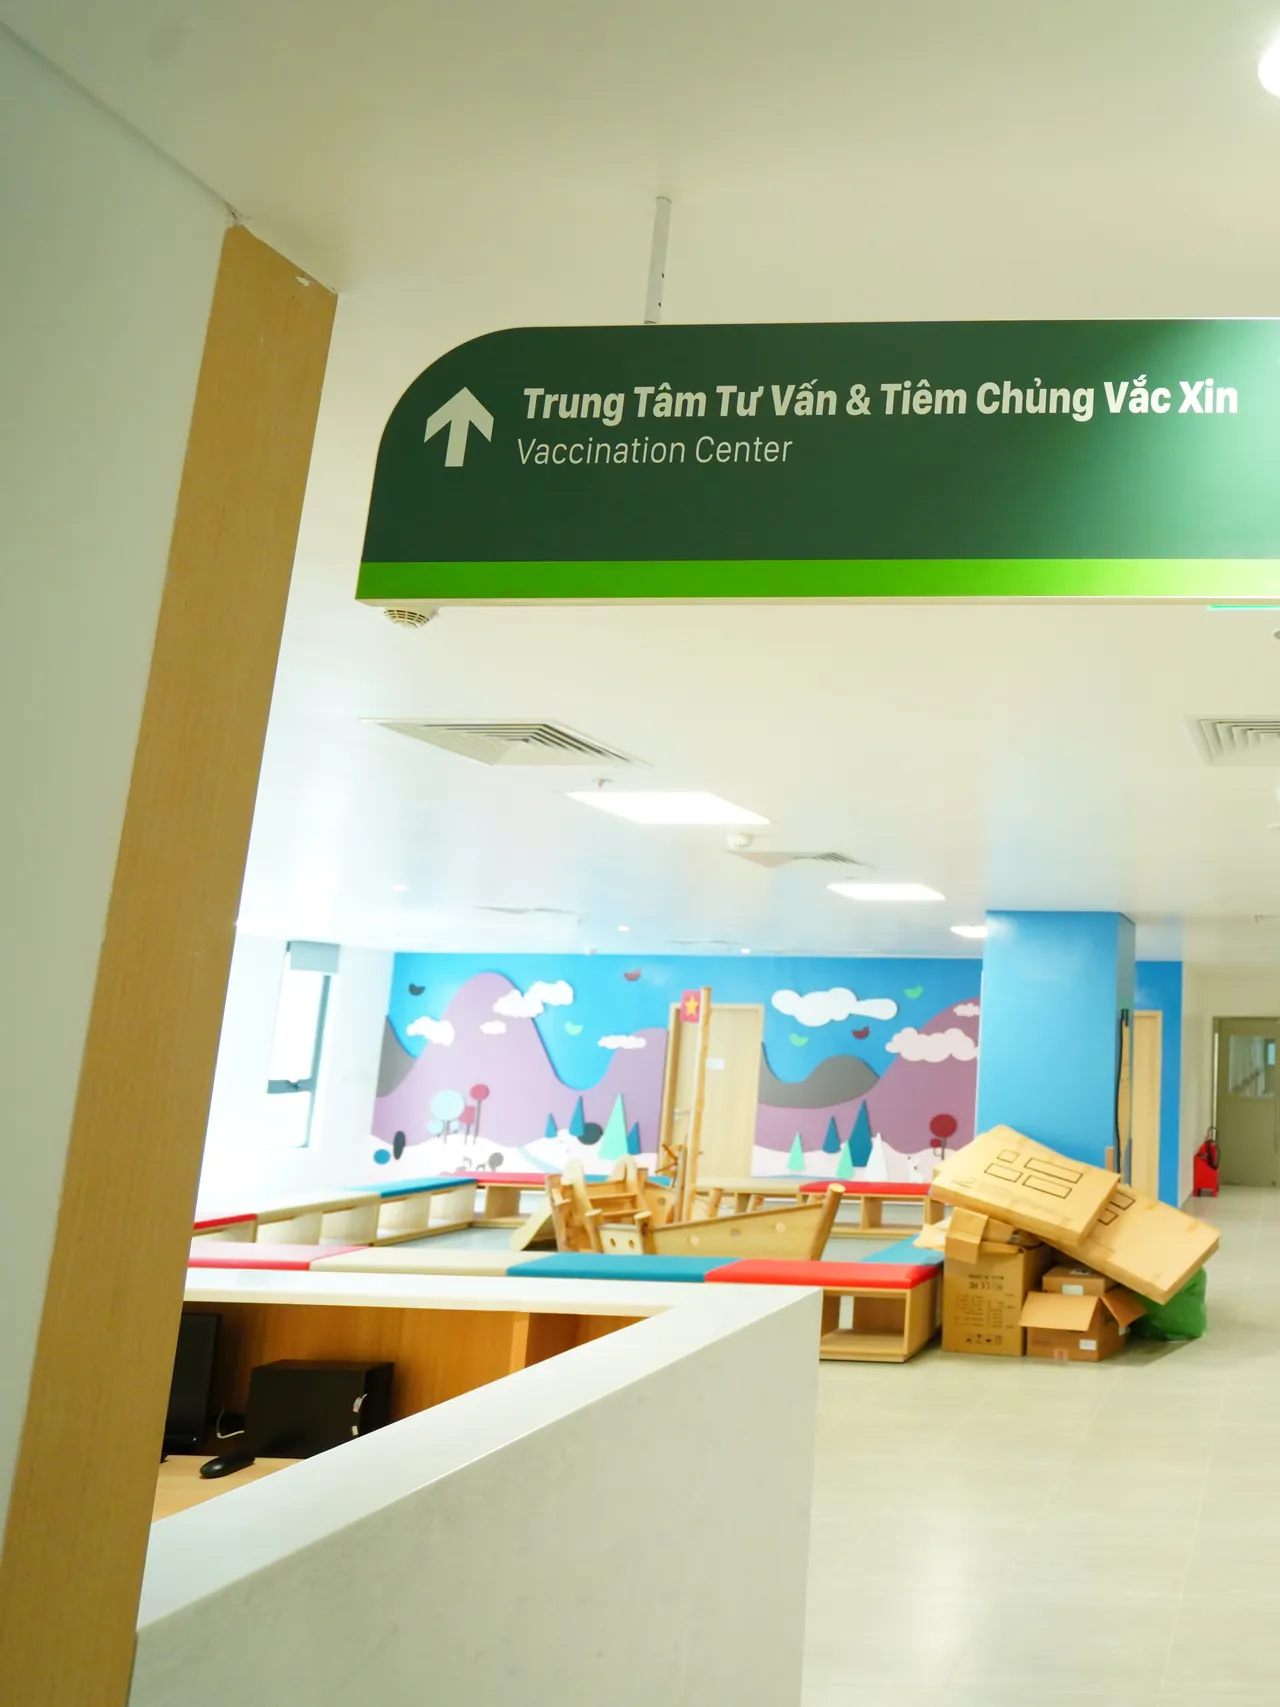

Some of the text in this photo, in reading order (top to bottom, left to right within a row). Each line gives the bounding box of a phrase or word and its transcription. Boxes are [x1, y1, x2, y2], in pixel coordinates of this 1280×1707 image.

[523, 374, 1239, 427] Trung Tâm Tư Vấn & Tiêm Chủng Vắc Xin
[517, 435, 793, 465] Vaccination Center
